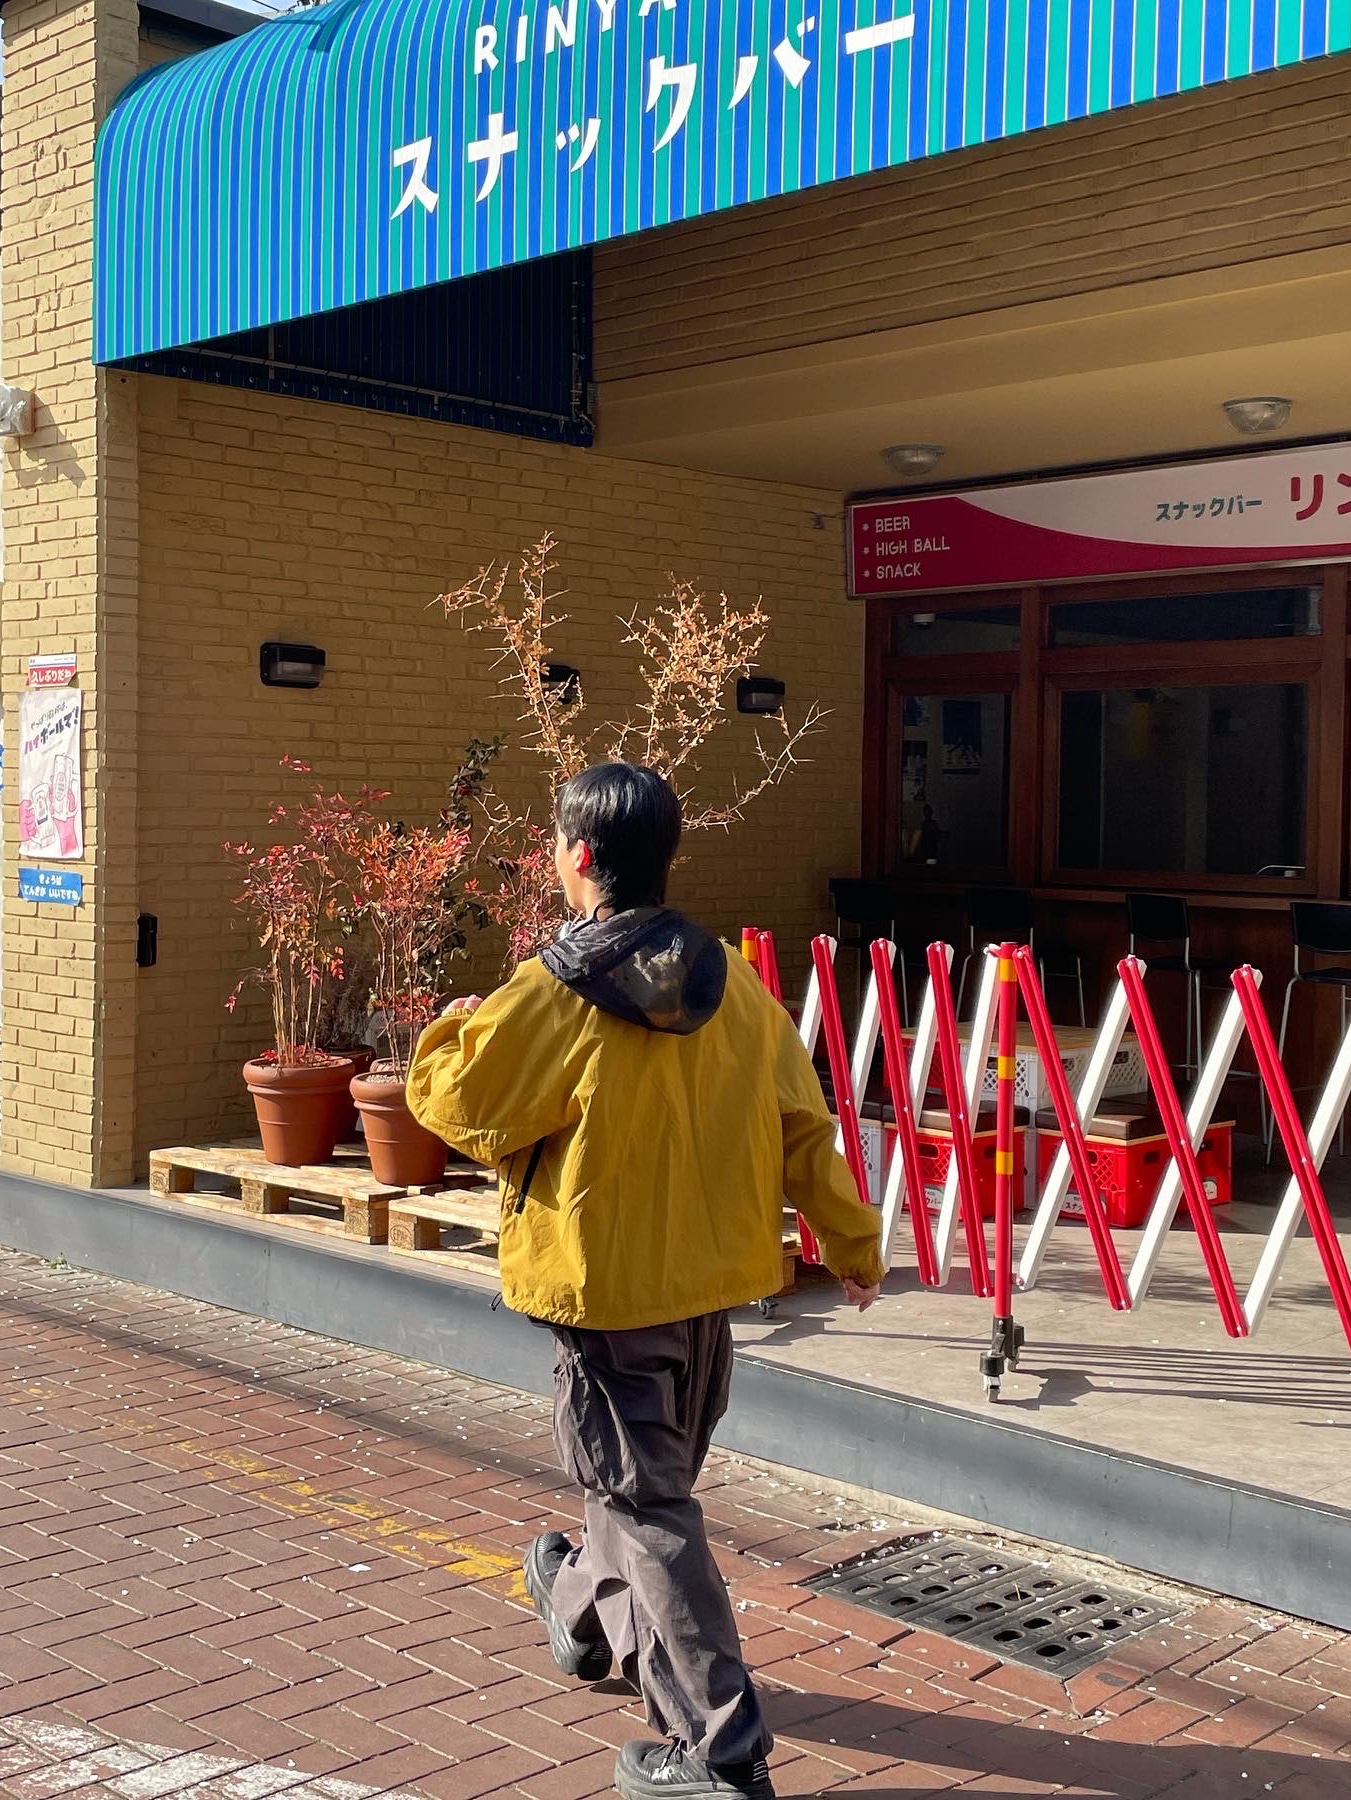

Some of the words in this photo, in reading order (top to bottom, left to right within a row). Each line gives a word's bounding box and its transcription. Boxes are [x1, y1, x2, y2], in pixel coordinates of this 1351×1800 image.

[390, 13, 915, 220] スナックバー
[1155, 494, 1263, 522] スナックバー
[875, 515, 911, 533] BEER
[876, 539, 908, 556] HIGH
[913, 535, 951, 553] BALL
[876, 562, 921, 579] SNACK
